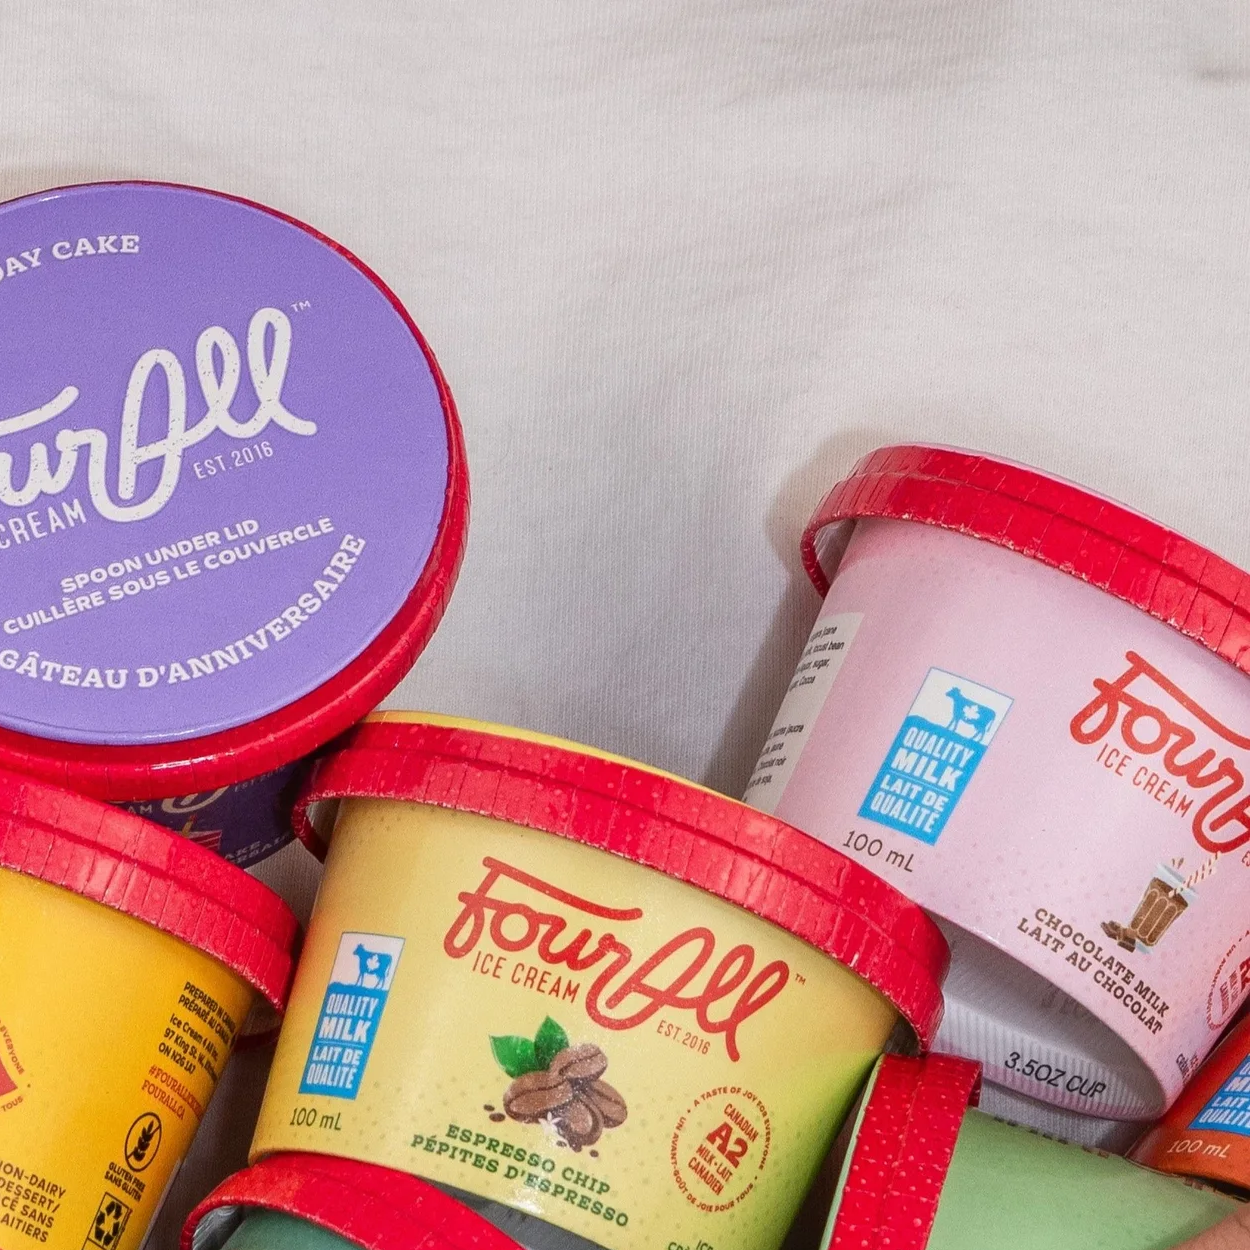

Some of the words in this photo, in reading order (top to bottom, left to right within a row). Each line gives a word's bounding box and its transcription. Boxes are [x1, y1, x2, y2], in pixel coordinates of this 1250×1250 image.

[52, 234, 140, 260] CAKE
[3, 591, 105, 635] CUILLÈRE
[108, 571, 171, 601] SOUS
[174, 560, 201, 583] LE
[204, 517, 334, 571] COUVERCLE
[60, 554, 142, 593] SPOON
[145, 534, 220, 567] UNDER
[223, 519, 259, 542] LID
[137, 534, 366, 689] D'ANNIVERSAIRE
[902, 726, 975, 768] QUALITY
[891, 748, 962, 791] MILK
[1097, 744, 1132, 776] ICE
[1133, 766, 1194, 818] CREAM
[869, 792, 939, 834] QUALITÉ
[880, 772, 922, 801] LAIT
[922, 788, 950, 814] DE
[841, 829, 884, 865] 100
[882, 848, 916, 874] mL
[472, 951, 507, 978] ICE
[511, 962, 581, 1004] CREAM
[1017, 917, 1065, 954] LAIT
[1066, 950, 1092, 974] AU
[1093, 969, 1164, 1035] CHOCOLAT
[1034, 907, 1136, 986] CHOCOLATE
[1134, 982, 1170, 1018] MILK
[184, 982, 218, 1012] PREPARED
[326, 993, 379, 1019] QUALITY
[170, 1013, 182, 1028] Ice
[182, 1022, 203, 1044] Cream
[318, 1017, 372, 1043] MILK
[306, 1063, 358, 1089] QUALITÉ
[312, 1045, 341, 1062] LAIT
[342, 1048, 361, 1065] DE
[1065, 1075, 1107, 1099] CUP
[289, 1107, 315, 1127] 100
[320, 1113, 342, 1130] mL
[446, 1124, 557, 1173] ESPRESSO
[561, 1167, 611, 1196] CHIP
[1167, 1139, 1203, 1154] 100
[1203, 1143, 1232, 1158] mL
[104, 1171, 121, 1188] SANS
[121, 1182, 142, 1202] GLUTEN
[109, 1162, 131, 1179] GLUTEN
[131, 1176, 145, 1193] FREE
[411, 1133, 499, 1173] PÉPITES
[503, 1163, 629, 1228] D'ESPRESSO
[21, 1205, 56, 1229] SANS
